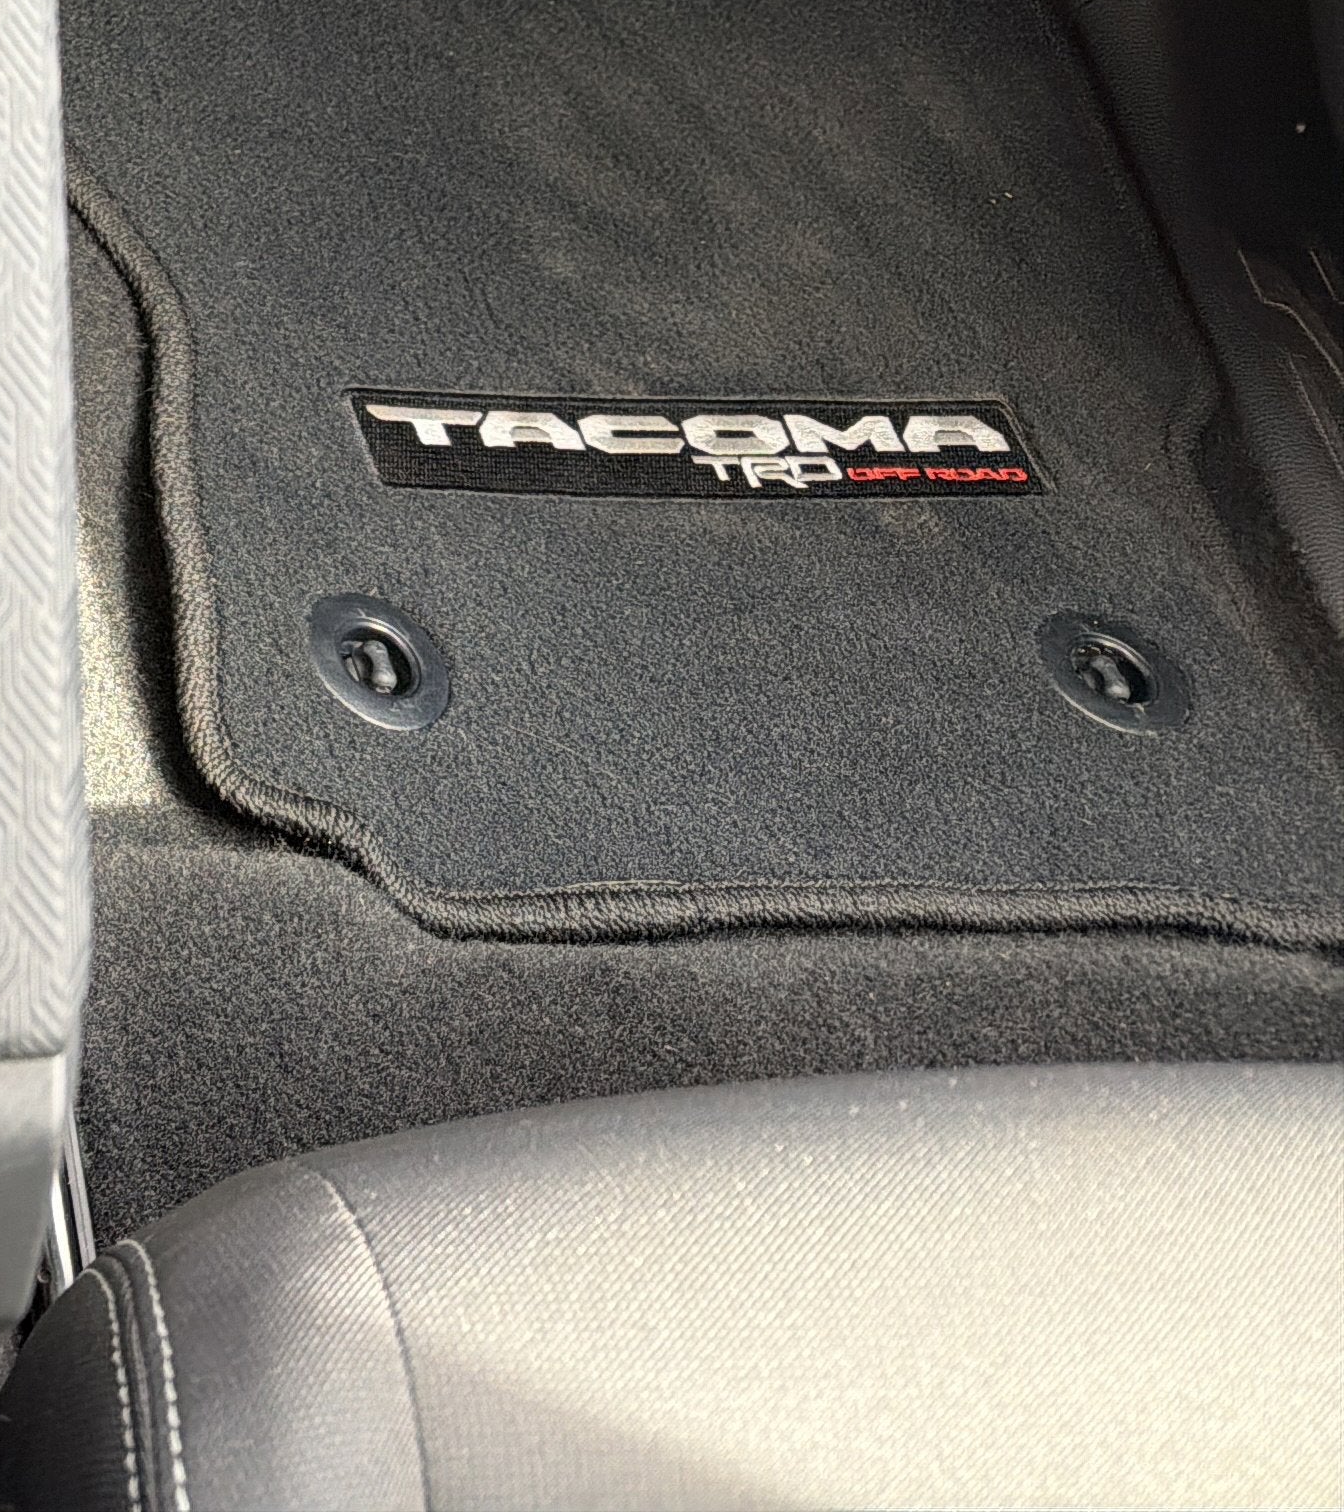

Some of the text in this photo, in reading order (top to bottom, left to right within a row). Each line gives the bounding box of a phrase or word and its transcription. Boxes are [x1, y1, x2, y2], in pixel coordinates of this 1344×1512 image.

[365, 404, 1011, 455] TACOMA
[691, 455, 1029, 489] TRD OFF ROAD
